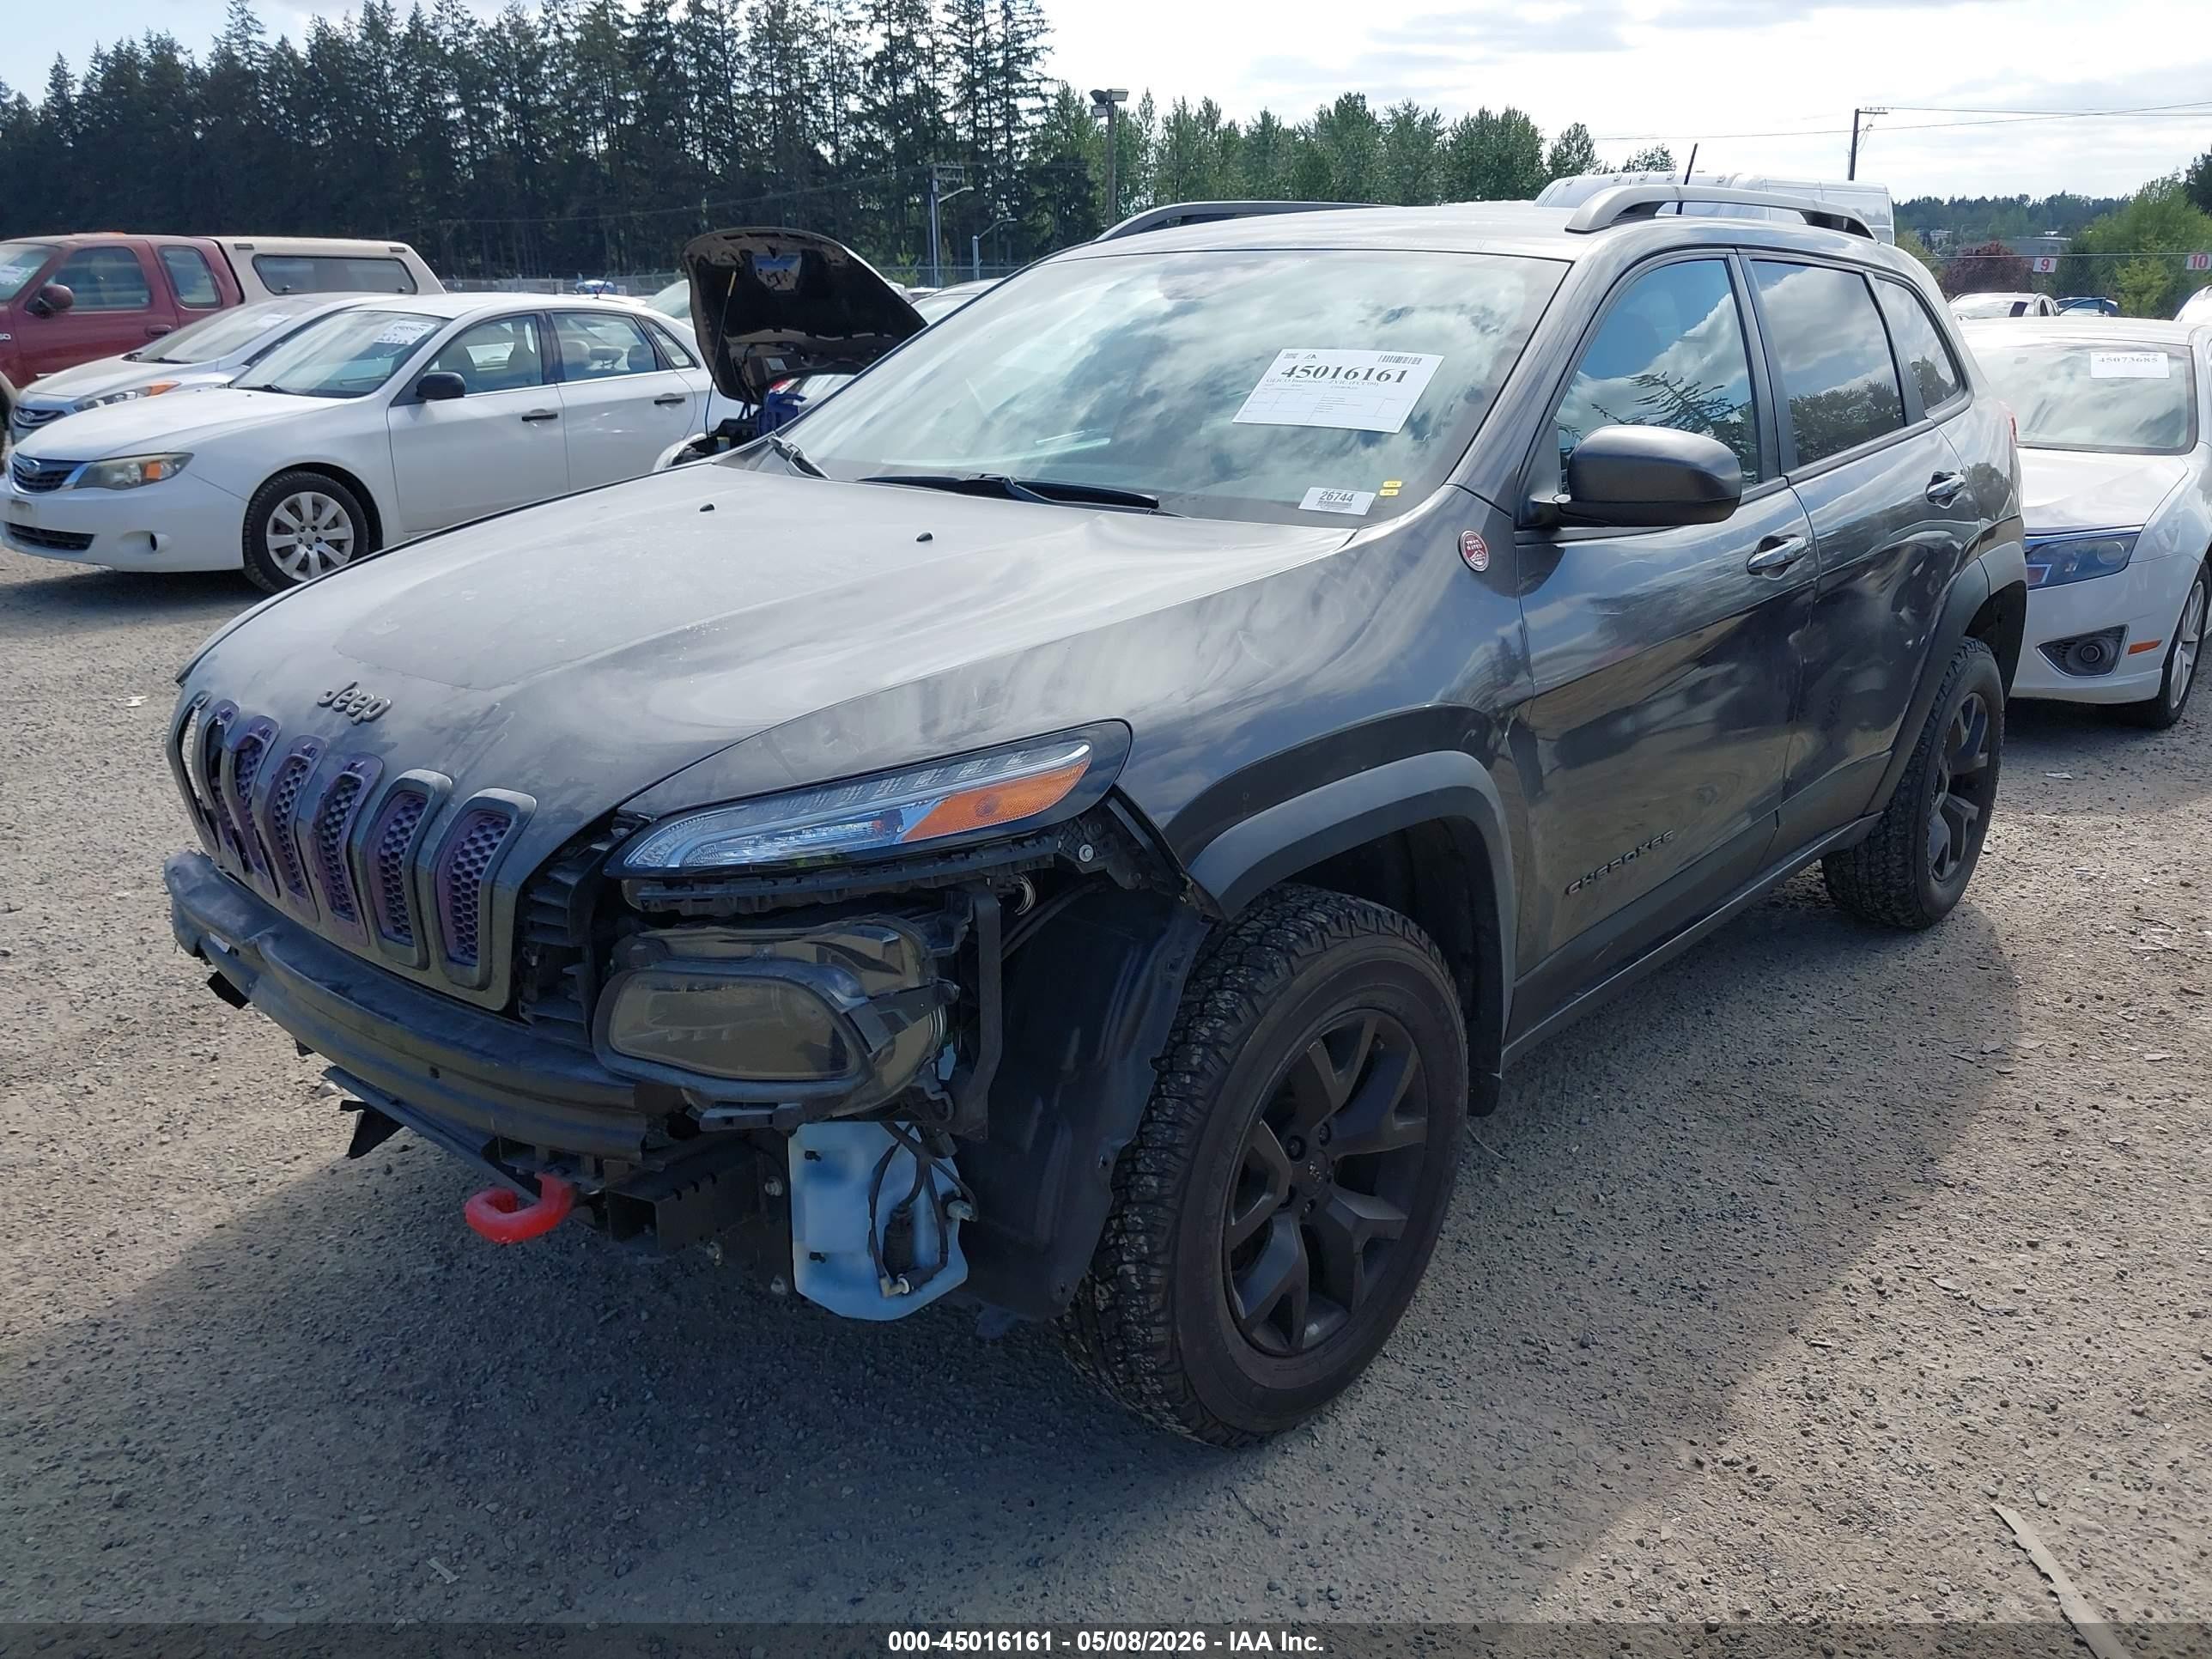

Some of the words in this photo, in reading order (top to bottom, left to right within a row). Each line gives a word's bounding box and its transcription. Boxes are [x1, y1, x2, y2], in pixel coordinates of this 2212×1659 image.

[2039, 258, 2051, 271] 9
[2191, 253, 2209, 269] 10
[1280, 364, 1408, 383] 45016161
[1319, 490, 1354, 502] 26744
[317, 680, 392, 726] Jeep
